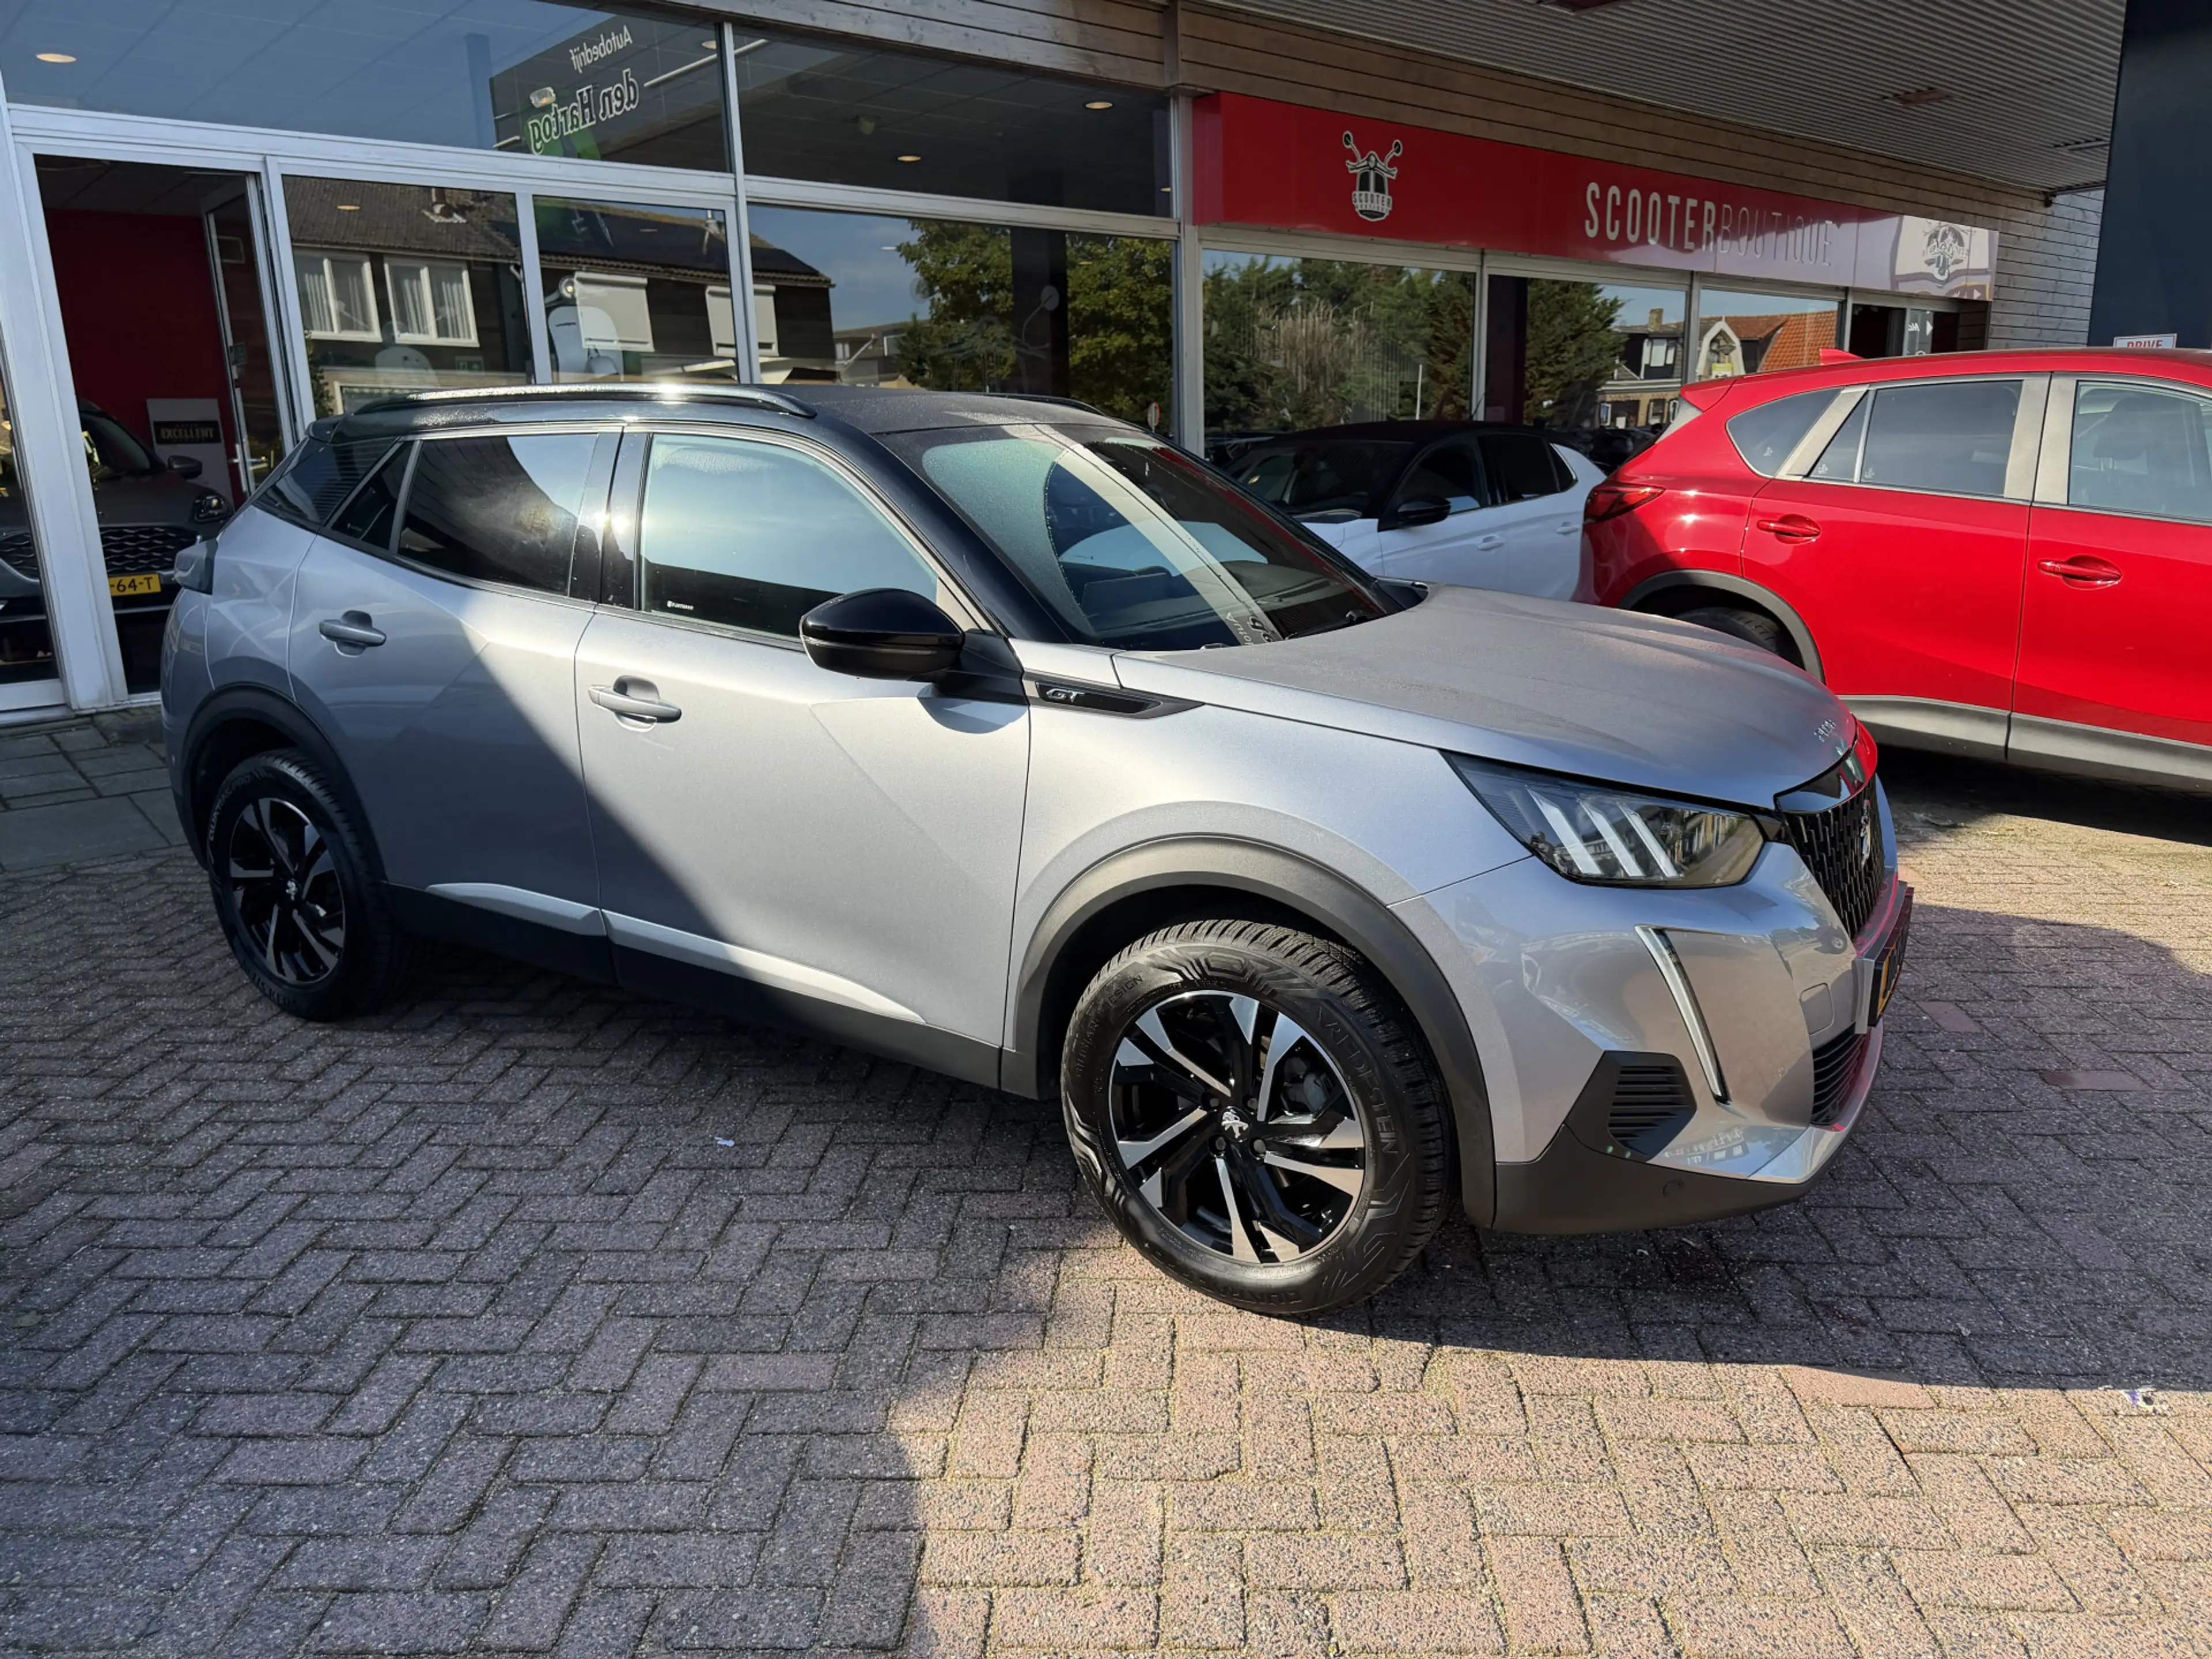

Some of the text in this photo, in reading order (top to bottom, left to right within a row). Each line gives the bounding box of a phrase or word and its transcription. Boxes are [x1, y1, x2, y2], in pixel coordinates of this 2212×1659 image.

[1353, 192, 1391, 209] SCOOTER
[160, 427, 215, 439] EXCELLENT
[1046, 688, 1085, 703] GT
